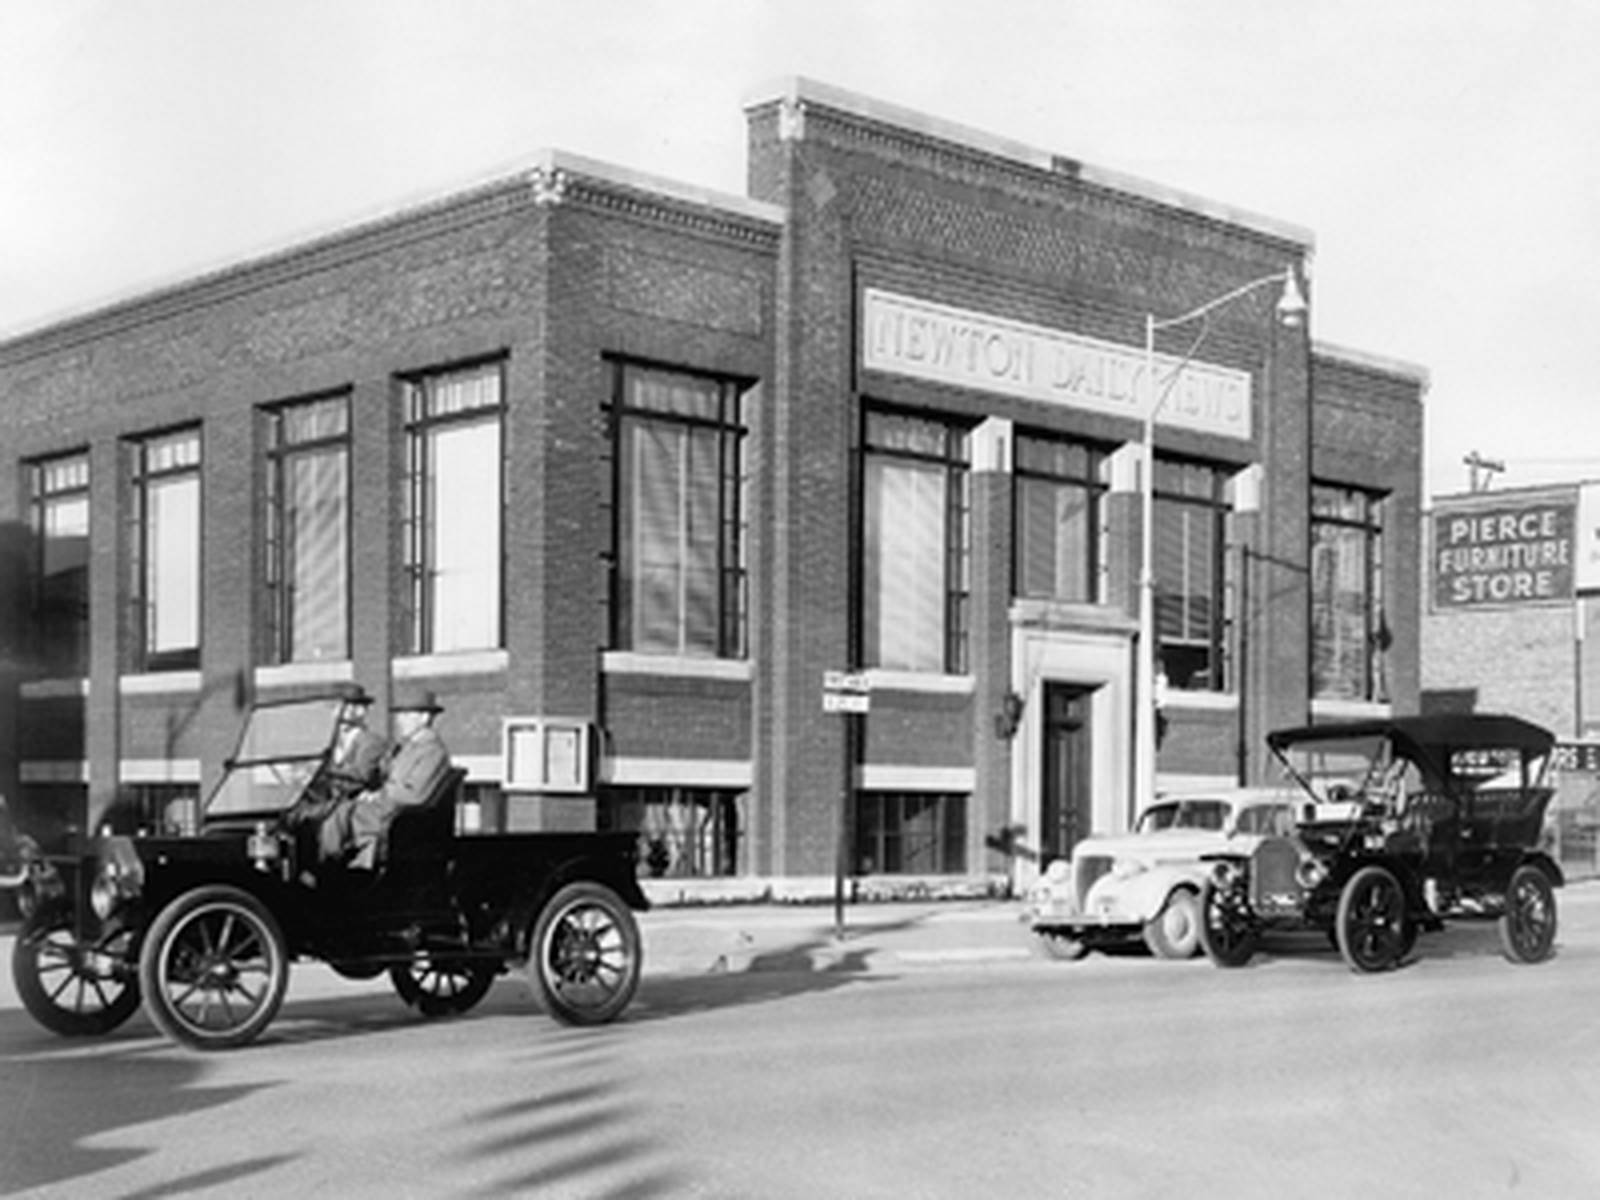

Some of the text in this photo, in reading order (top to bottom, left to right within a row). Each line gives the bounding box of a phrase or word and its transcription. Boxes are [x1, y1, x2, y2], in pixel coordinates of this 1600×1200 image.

[874, 309, 1034, 384] NEWTON
[1052, 345, 1146, 404] DAILY
[1451, 511, 1557, 544] PIERCE
[1439, 539, 1569, 573] FURNITURE
[1452, 570, 1553, 601] STORE
